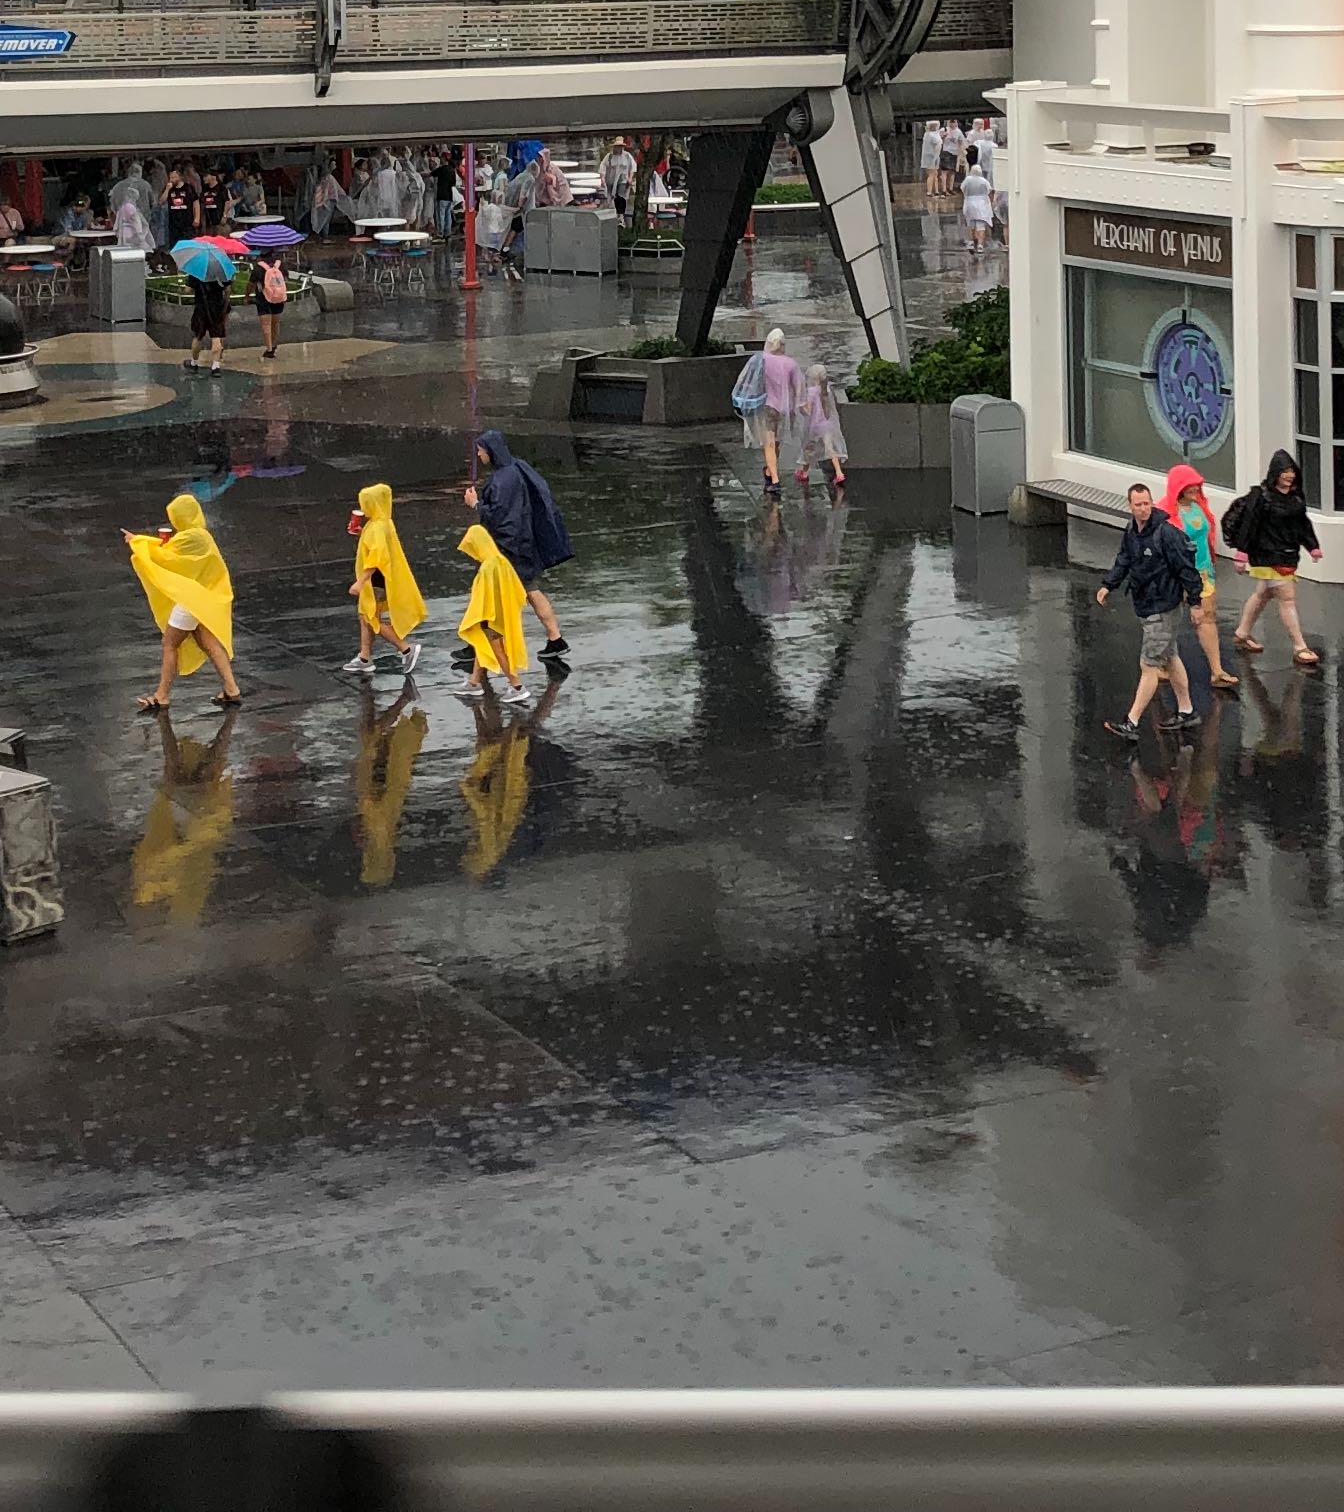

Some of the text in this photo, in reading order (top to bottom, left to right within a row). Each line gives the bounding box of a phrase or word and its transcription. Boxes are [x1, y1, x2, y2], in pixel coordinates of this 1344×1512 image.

[1093, 215, 1222, 267] MERCHANT OF VENUS
